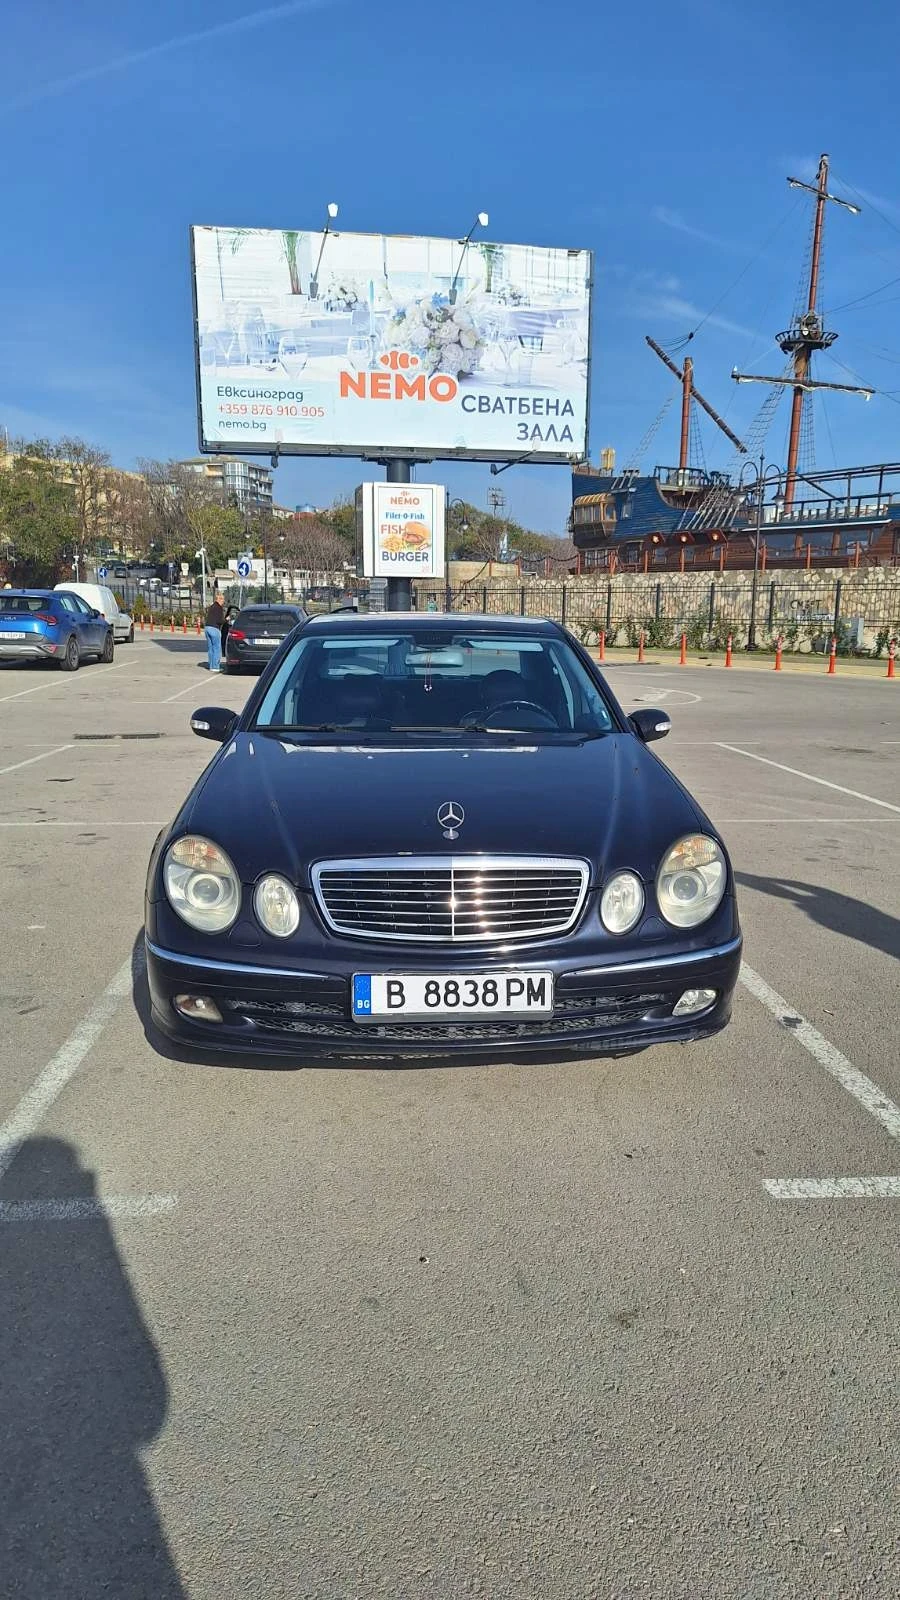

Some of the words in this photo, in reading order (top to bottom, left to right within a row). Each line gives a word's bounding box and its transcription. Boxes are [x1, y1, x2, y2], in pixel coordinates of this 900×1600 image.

[340, 371, 457, 402] NEMO
[217, 386, 304, 403] Евксиноград
[218, 403, 248, 414] +359
[251, 404, 273, 415] 876
[276, 405, 298, 416] 910
[301, 406, 325, 417] 905
[461, 395, 575, 417] СВАТБЕНА
[218, 420, 267, 431] nemo.bg
[516, 423, 574, 443] ЗАЛА
[390, 496, 420, 506] NEMO
[380, 524, 407, 535] FISH
[381, 551, 429, 562] BURGER
[386, 980, 406, 1008] B
[424, 979, 499, 1007] 8838
[505, 977, 546, 1006] PM
[357, 1000, 370, 1009] BG
